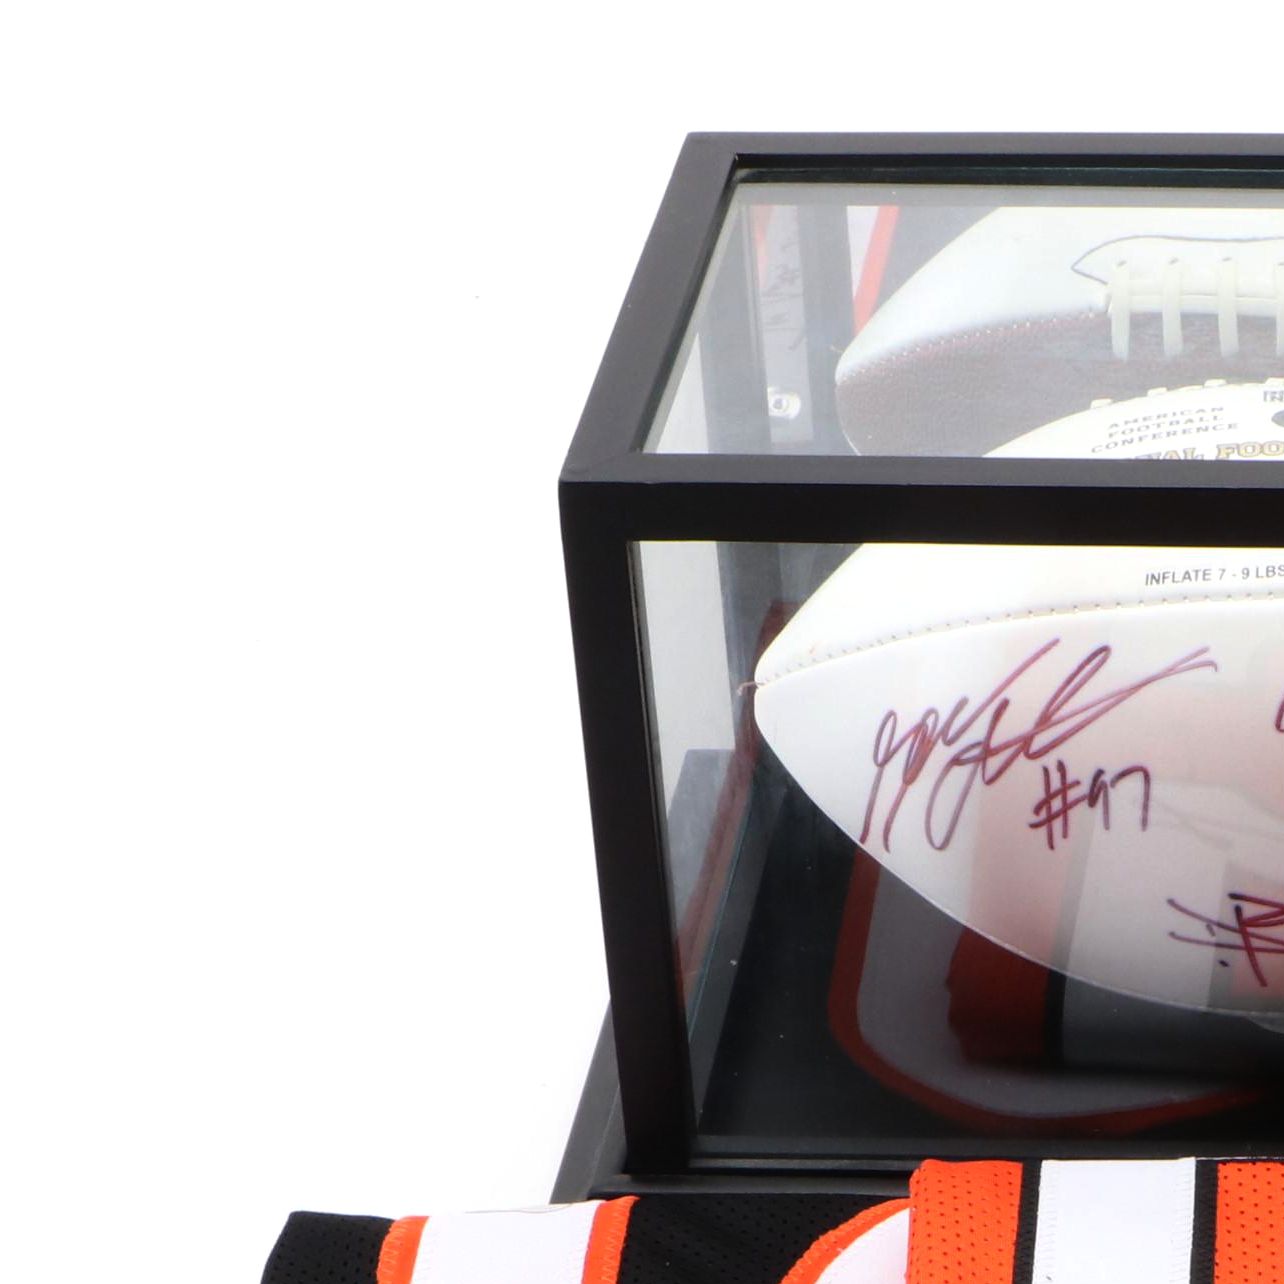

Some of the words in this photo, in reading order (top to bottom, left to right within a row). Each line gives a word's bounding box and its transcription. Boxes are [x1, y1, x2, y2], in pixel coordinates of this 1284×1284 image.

[1108, 406, 1224, 430] AMERICAN
[1108, 414, 1223, 438] FOOTBALL
[1091, 422, 1239, 453] CONFERENCE
[1145, 567, 1212, 585] INFLATE
[1218, 568, 1227, 582] 7
[1241, 567, 1250, 581] 9
